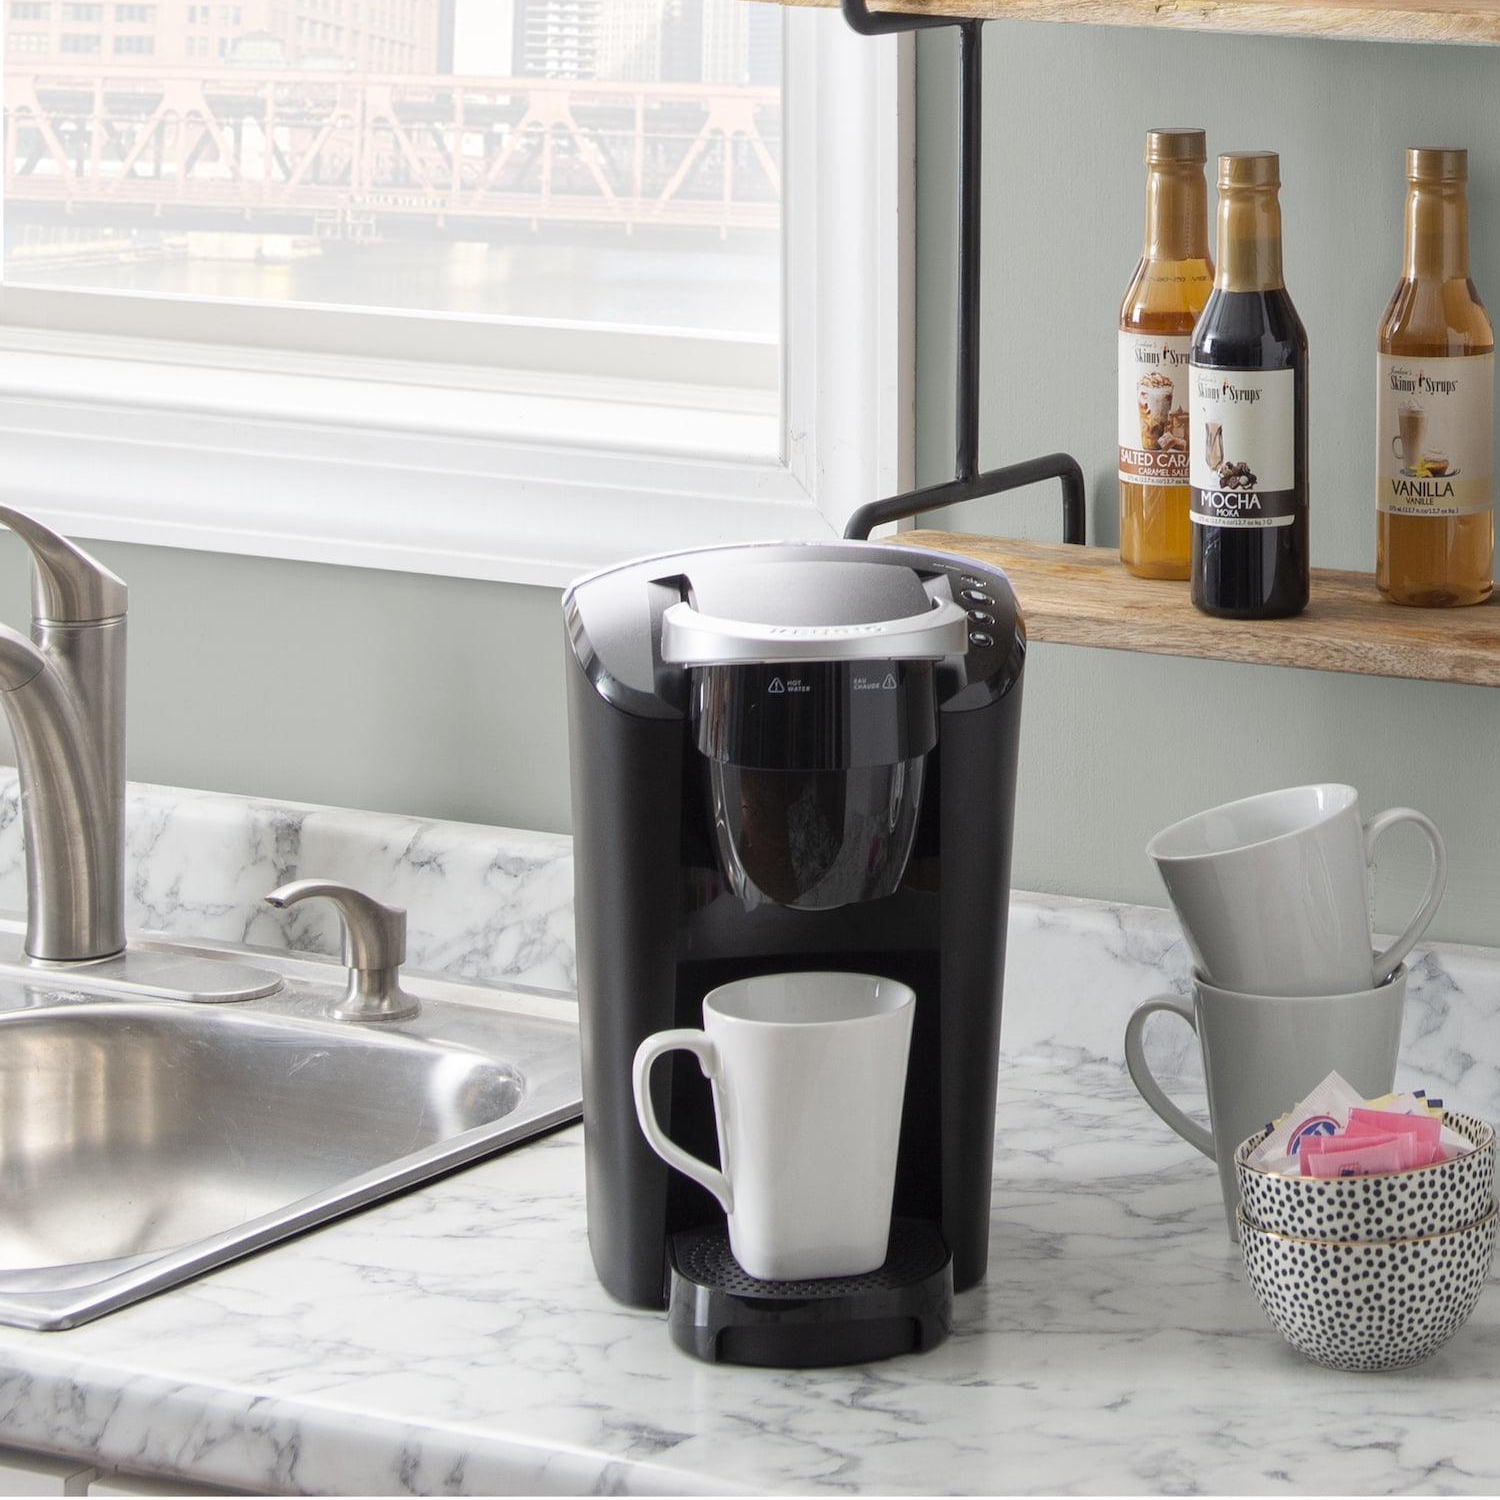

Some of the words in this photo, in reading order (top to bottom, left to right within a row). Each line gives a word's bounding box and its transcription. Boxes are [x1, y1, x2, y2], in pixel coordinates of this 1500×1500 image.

[1135, 348, 1160, 367] Skinny
[1170, 349, 1190, 367] Syru
[1390, 375, 1416, 395] Skinny
[1425, 377, 1456, 395] Syrups
[1229, 385, 1260, 404] Syrups
[1120, 449, 1153, 467] SALTED
[1138, 467, 1170, 476] CARAMEL
[1392, 479, 1454, 497] VANILLA
[1201, 490, 1261, 509] MOCHA
[1406, 497, 1434, 505] VANILLE
[1216, 509, 1240, 517] MOKA
